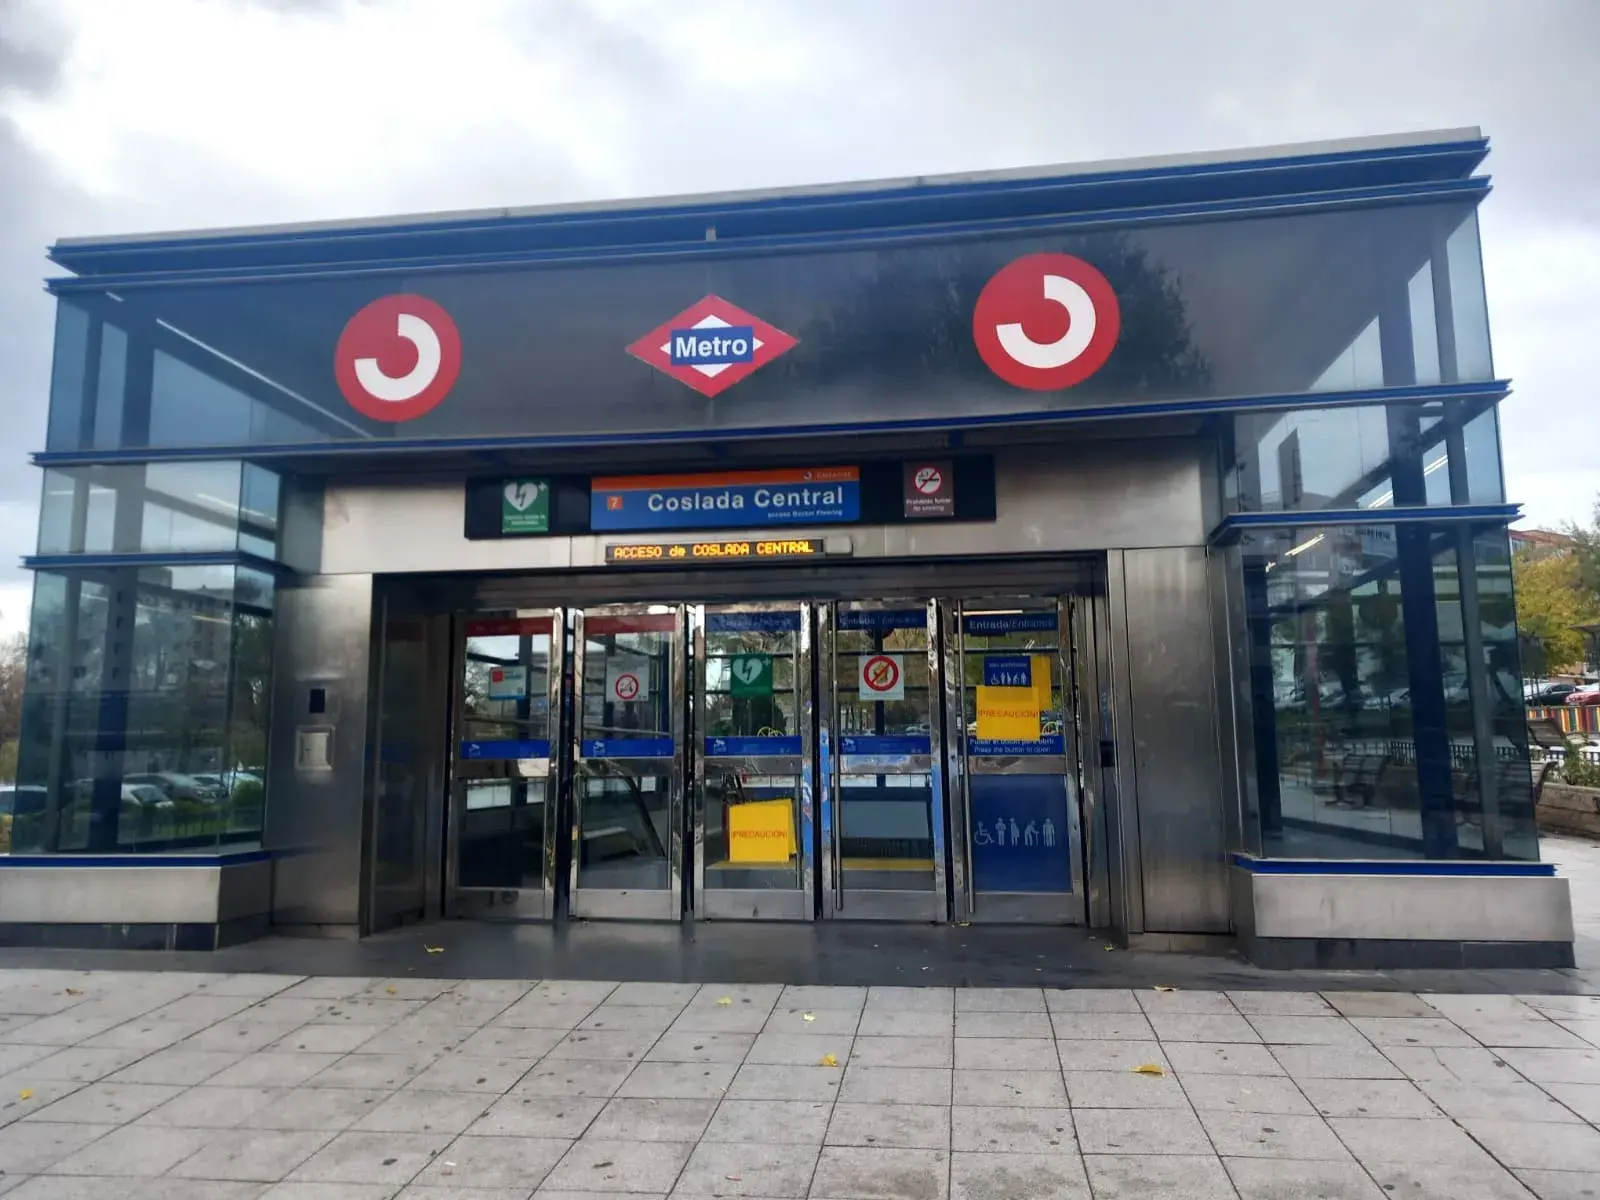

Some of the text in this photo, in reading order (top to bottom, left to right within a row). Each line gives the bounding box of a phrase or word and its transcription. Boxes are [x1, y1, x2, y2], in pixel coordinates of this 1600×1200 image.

[676, 336, 748, 358] Metro
[648, 485, 843, 512] Coslada Central
[614, 541, 814, 559] ACCESO de COSLADA CENTRAL
